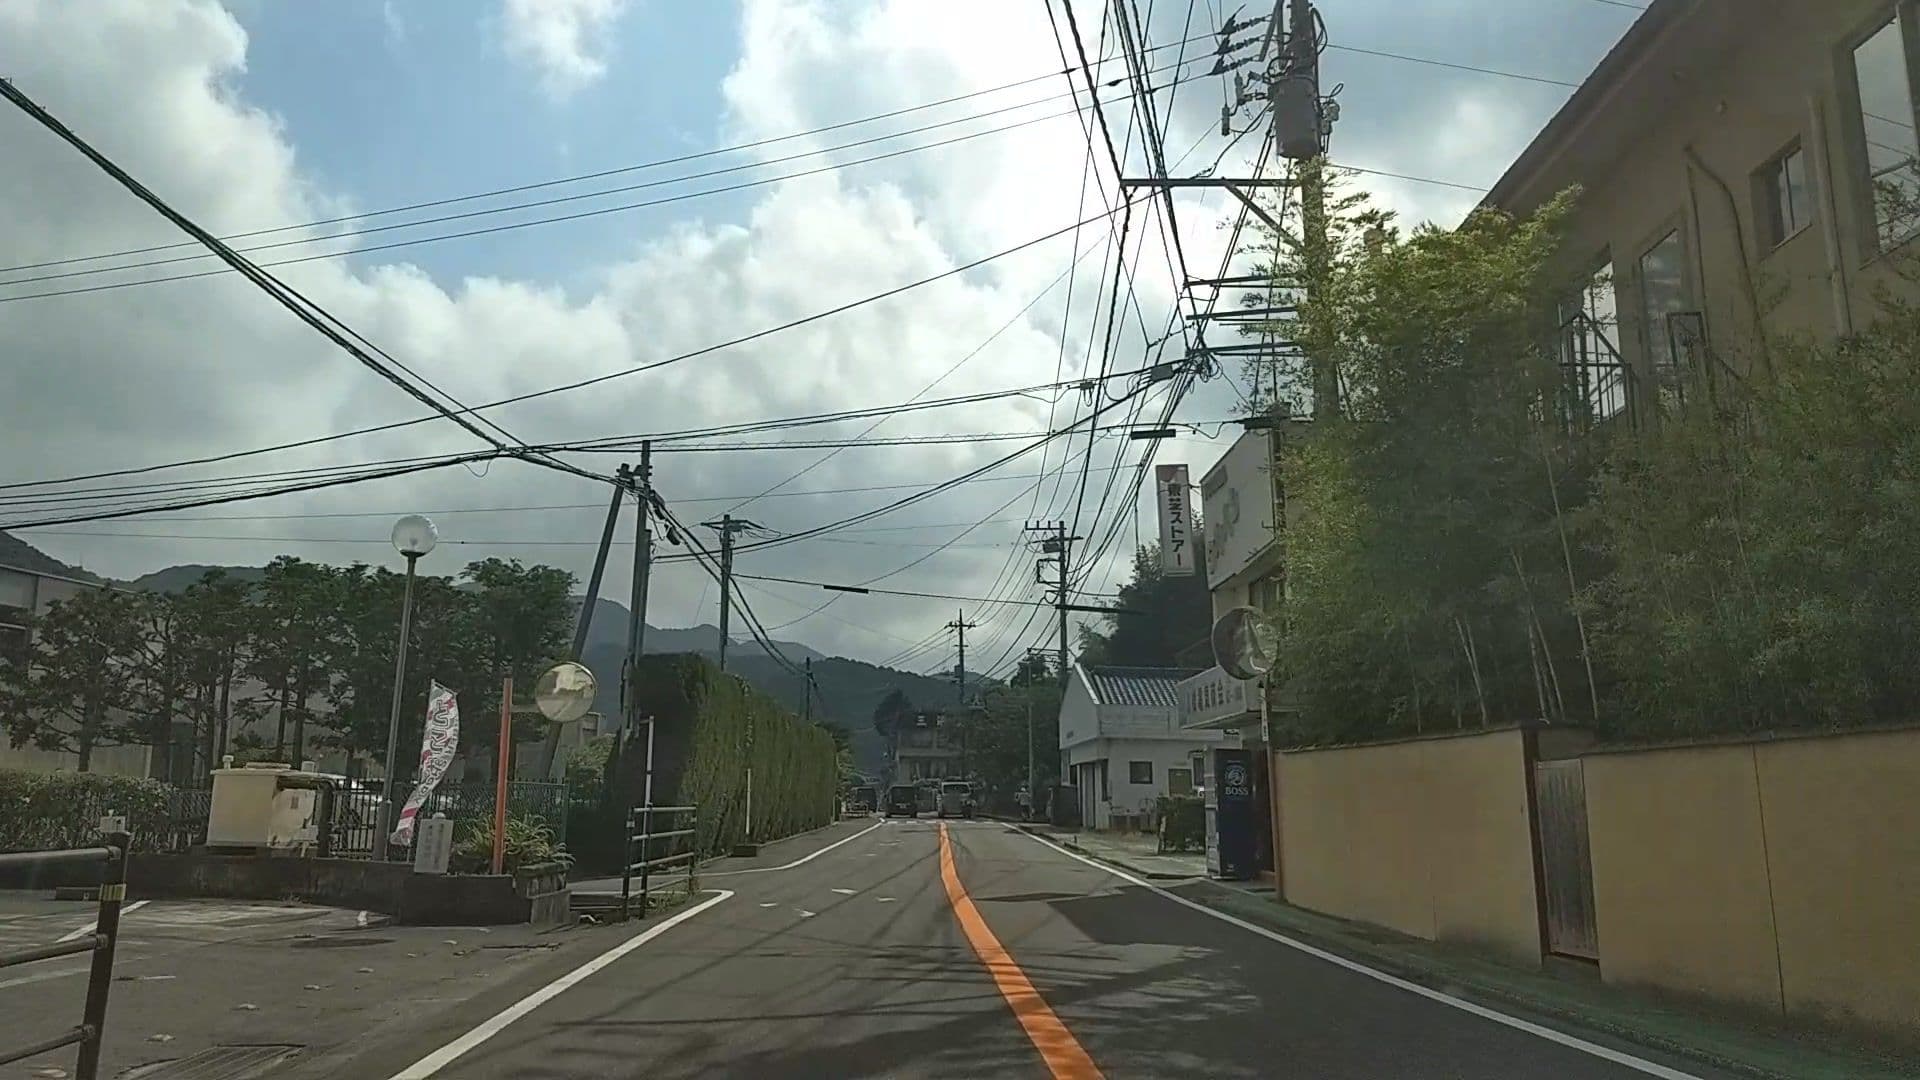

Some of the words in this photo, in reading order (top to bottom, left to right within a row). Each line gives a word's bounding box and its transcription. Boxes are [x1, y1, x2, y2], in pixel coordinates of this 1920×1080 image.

[1167, 483, 1185, 566] 東芝ストアー
[1225, 786, 1248, 795] BOSS
